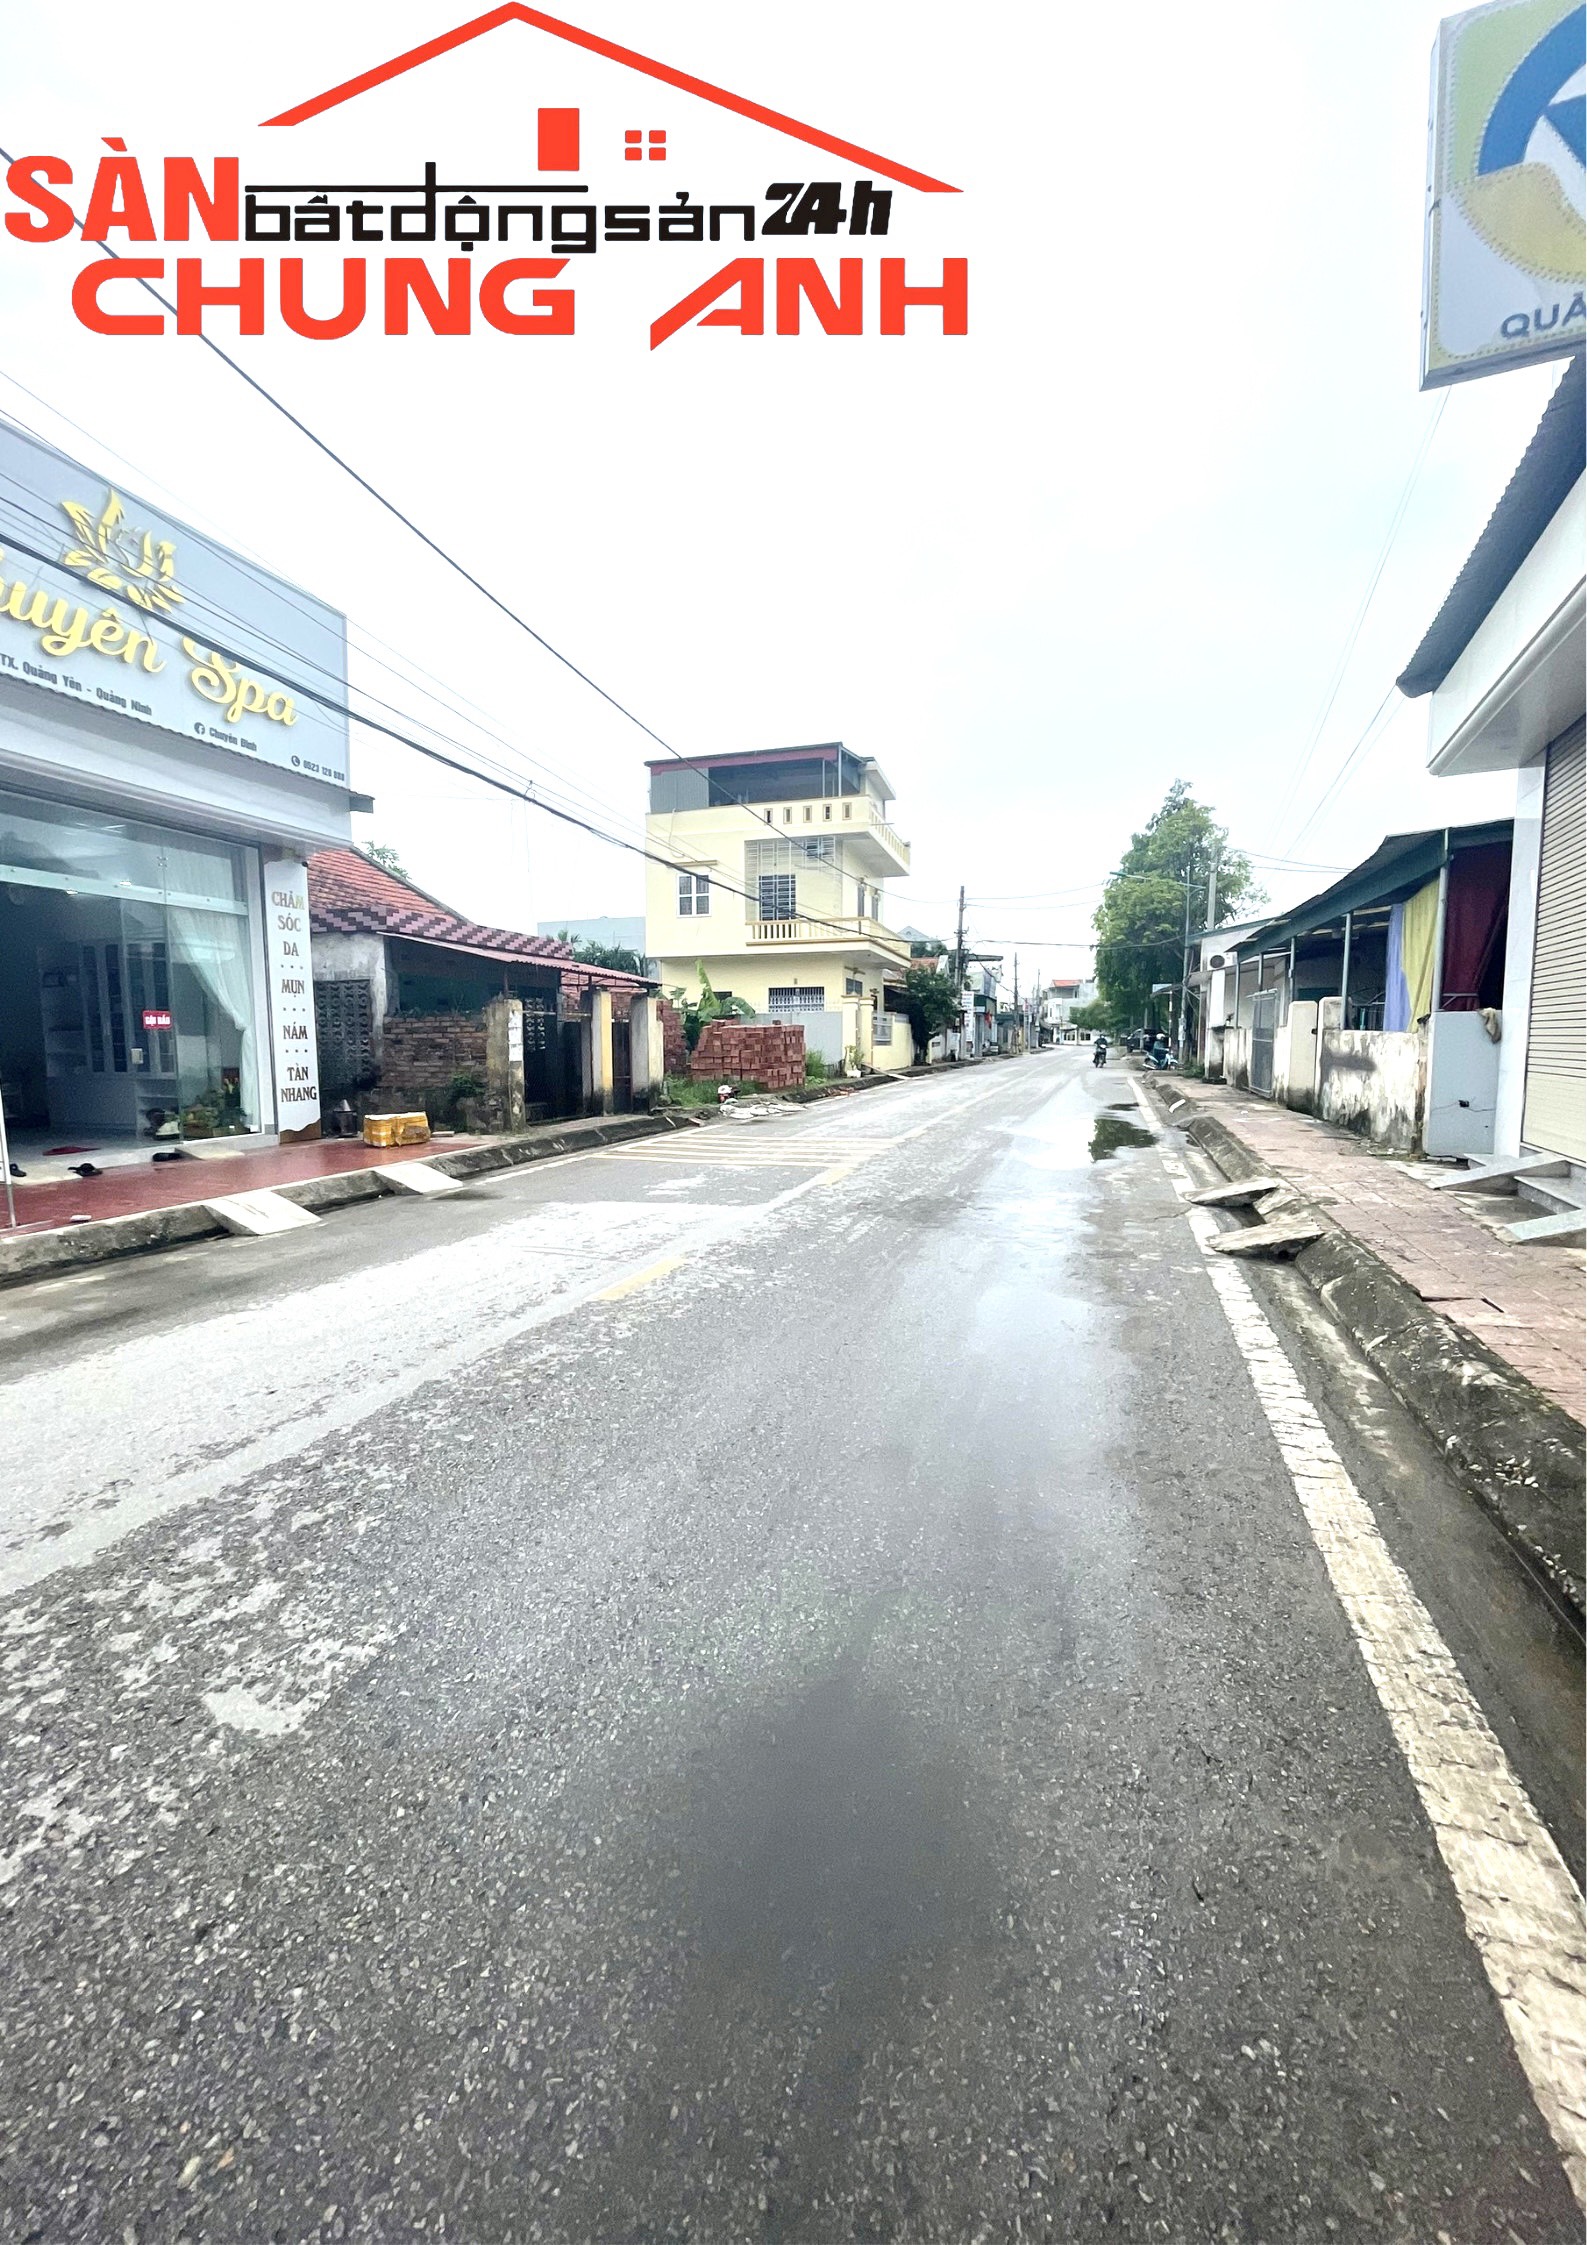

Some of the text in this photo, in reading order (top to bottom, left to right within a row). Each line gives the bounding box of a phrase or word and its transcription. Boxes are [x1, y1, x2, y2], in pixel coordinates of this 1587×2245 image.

[183, 636, 299, 726] Spa
[278, 912, 302, 932] SÓC
[282, 940, 300, 956] DA
[281, 979, 305, 998] MỤN
[283, 1021, 308, 1040] NÁM
[286, 1062, 309, 1081] TÀN
[280, 1086, 317, 1103] NHANG
